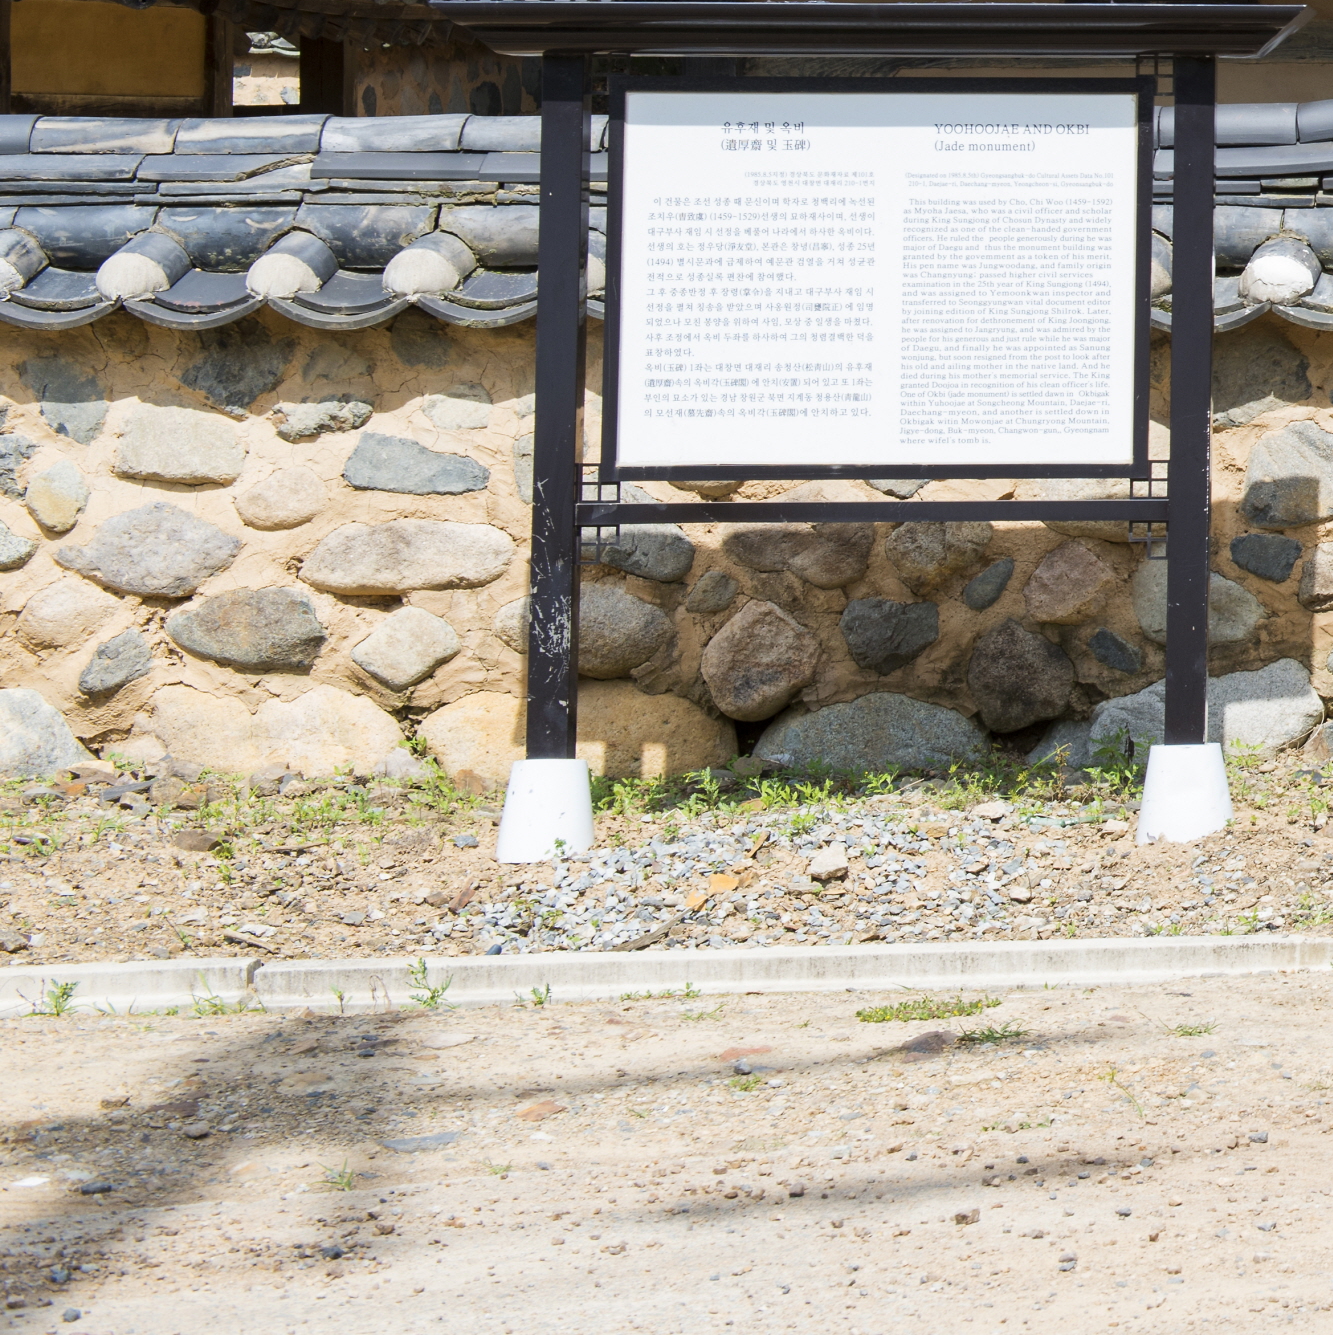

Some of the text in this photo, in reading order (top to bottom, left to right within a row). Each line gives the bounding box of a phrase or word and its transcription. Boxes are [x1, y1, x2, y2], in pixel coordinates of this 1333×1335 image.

[722, 121, 804, 134] 유후재 및 옥비
[934, 124, 1089, 134] YOOHOOJAE AND OKBI
[767, 139, 776, 151] 및
[783, 139, 810, 151] 玉碑)
[935, 140, 1035, 151] (Jade monument)
[654, 197, 874, 206] 이 건물은 조선 성종 때 문신이며 학자로 청백리에 녹선된
[932, 216, 950, 224] King
[953, 216, 990, 224] Sungjong
[1034, 216, 1066, 224] Dynasty
[648, 227, 682, 236] 대구부사
[685, 227, 701, 236] 재임
[705, 227, 712, 236] 시
[716, 227, 741, 236] 선정을
[772, 227, 806, 236] 나라에서
[810, 227, 834, 236] 하사한
[838, 227, 874, 236] 옥비이다.
[647, 258, 673, 266] (1494)
[726, 257, 762, 266] 급제하여
[766, 257, 793, 266] 예문관
[828, 257, 844, 266] 거쳐
[848, 257, 875, 266] 성균관
[647, 272, 796, 282] 전적으로 성종실록 편찬에 참여했다.
[980, 271, 1006, 279] passed
[1009, 271, 1036, 279] higher
[646, 317, 681, 327] 되었으나
[684, 317, 700, 327] 모친
[704, 317, 730, 327] 봉양을
[734, 317, 758, 326] 위하여
[785, 317, 802, 326] 모상
[804, 317, 812, 326] 중
[816, 317, 841, 326] 일생을
[844, 317, 872, 326] 마쳤다.
[646, 332, 874, 342] 사후 조정에서 옥비 두좌를 하사하여 그의 청렴결백한 덕을
[645, 348, 694, 357] 표창하였다.
[928, 399, 965, 407] Yuhoojae
[977, 399, 1025, 407] Songcheong
[900, 418, 934, 426] Okbigak
